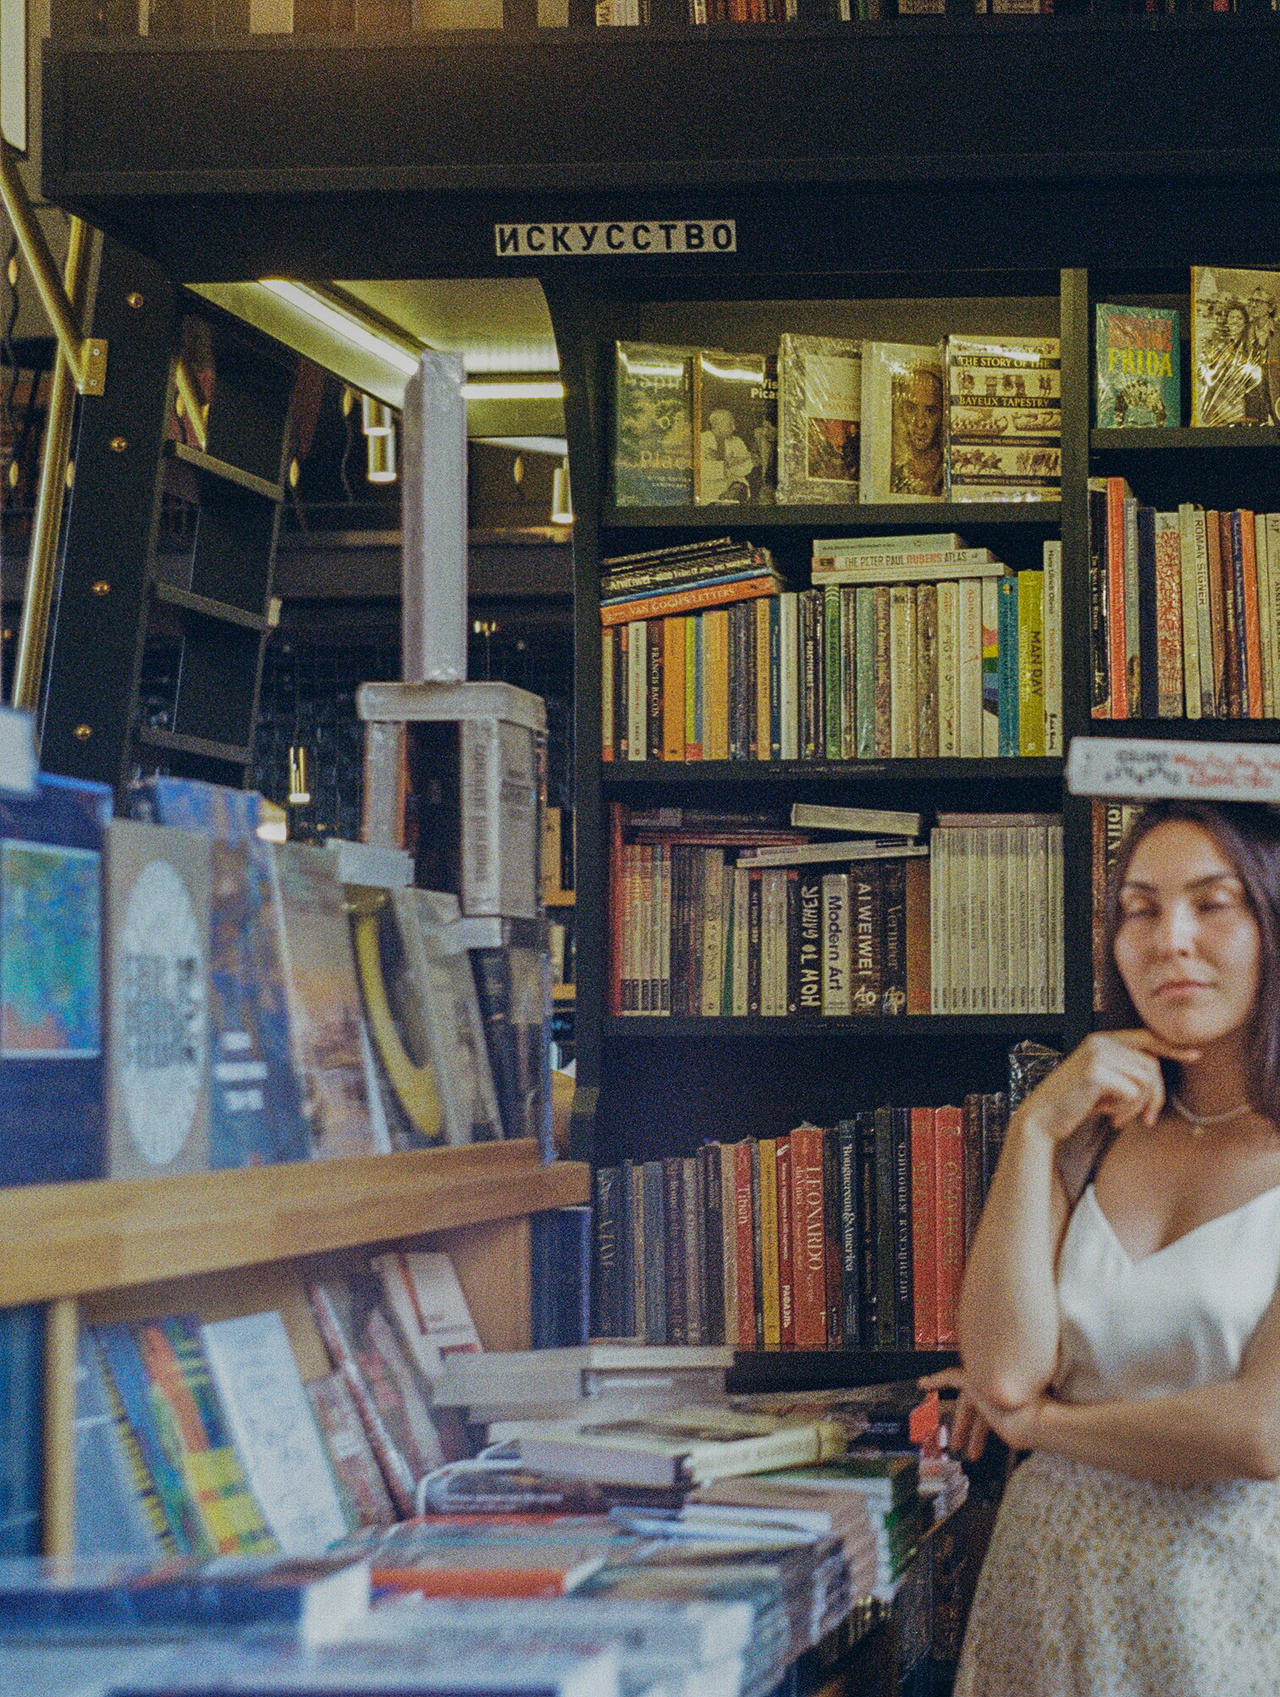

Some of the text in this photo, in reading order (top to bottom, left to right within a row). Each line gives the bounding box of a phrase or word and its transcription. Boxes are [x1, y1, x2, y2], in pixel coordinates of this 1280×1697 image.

[497, 223, 733, 253] ИСКУССТВО
[960, 357, 979, 367] THE
[981, 356, 1012, 367] STORY
[1014, 357, 1027, 368] OF
[1108, 347, 1173, 377] FRIDA
[959, 397, 1049, 408] BAYEUX TAPESTRY
[844, 551, 967, 568] THE PETER PAUL RUBENS ATLAS
[1194, 519, 1207, 606] ROMAN SIGNER
[691, 587, 736, 604] LETTERS
[651, 646, 661, 717] FRANCIS BACON
[1030, 631, 1043, 698] MAN RAY
[800, 884, 820, 1007] HOW TO GATHER
[827, 896, 843, 991] Modern Art
[858, 883, 872, 975] AI WEIWEI
[887, 904, 902, 970] Vermeer
[736, 1186, 751, 1225] Titian
[805, 1165, 823, 1271] LEONARDO
[897, 1141, 908, 1301] АНГЛИЙСКАЯ ЖИВОПИСЬ
[845, 1224, 855, 1271] America
[782, 1284, 791, 1329] РАФАЭЛЬ
